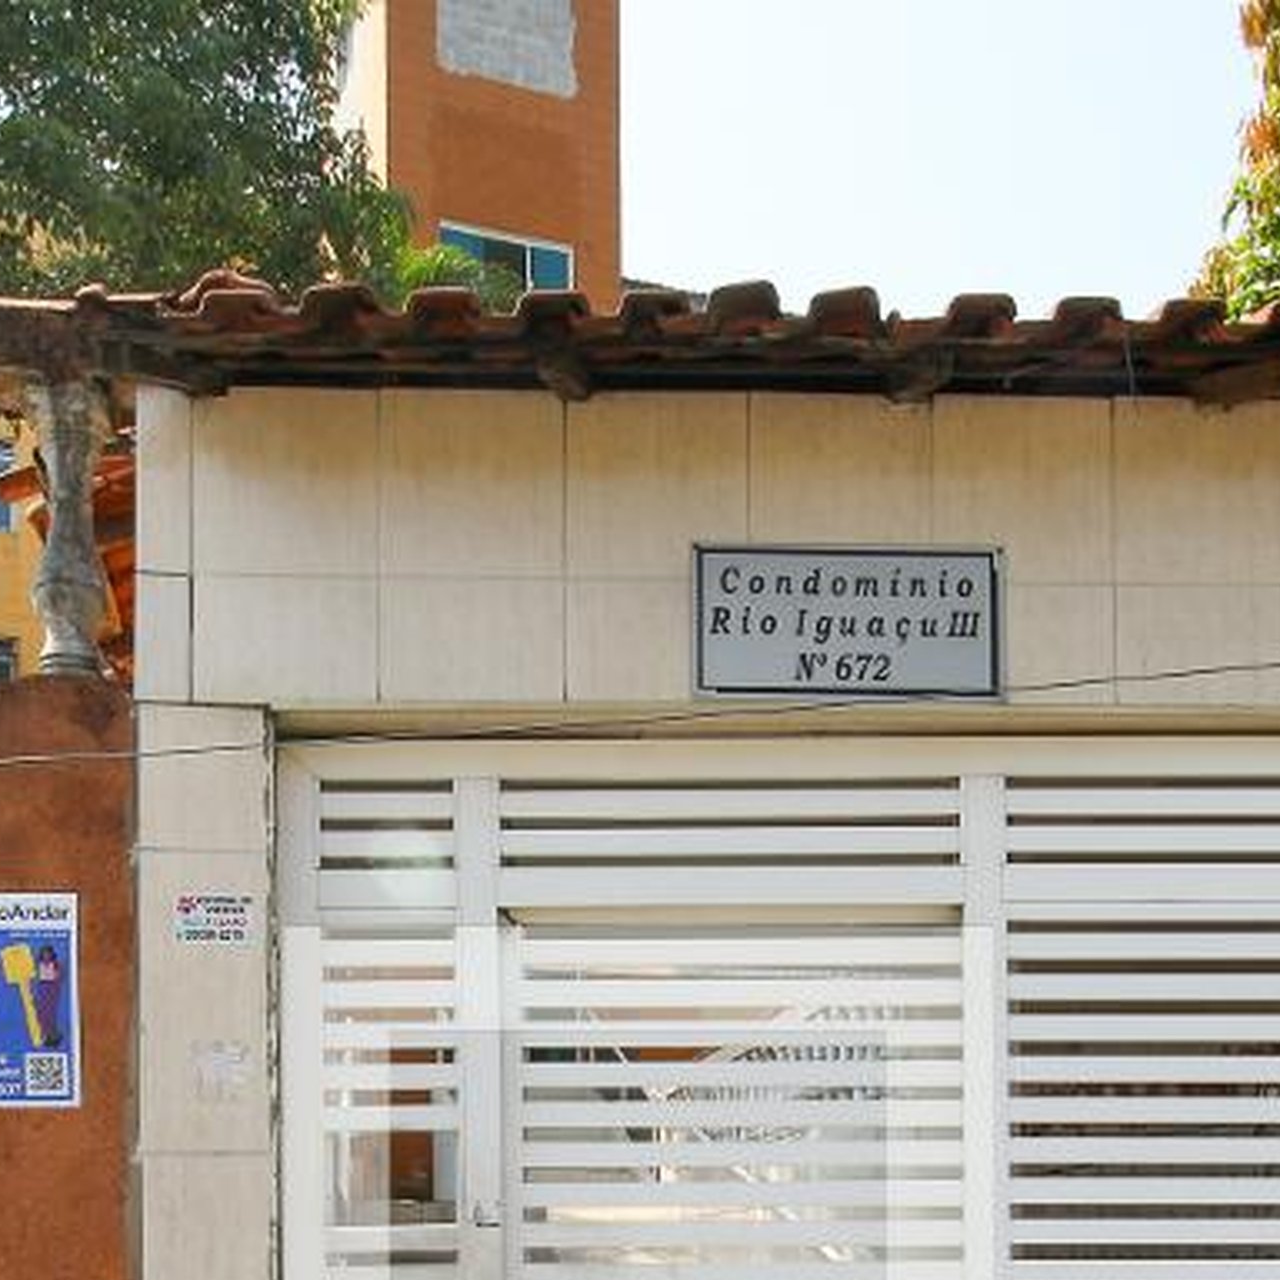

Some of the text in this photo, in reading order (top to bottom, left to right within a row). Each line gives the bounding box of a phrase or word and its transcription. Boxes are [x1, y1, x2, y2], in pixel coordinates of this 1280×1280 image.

[710, 605, 778, 635] Rio
[795, 609, 938, 647] Iguaçu
[834, 653, 892, 682] 672
